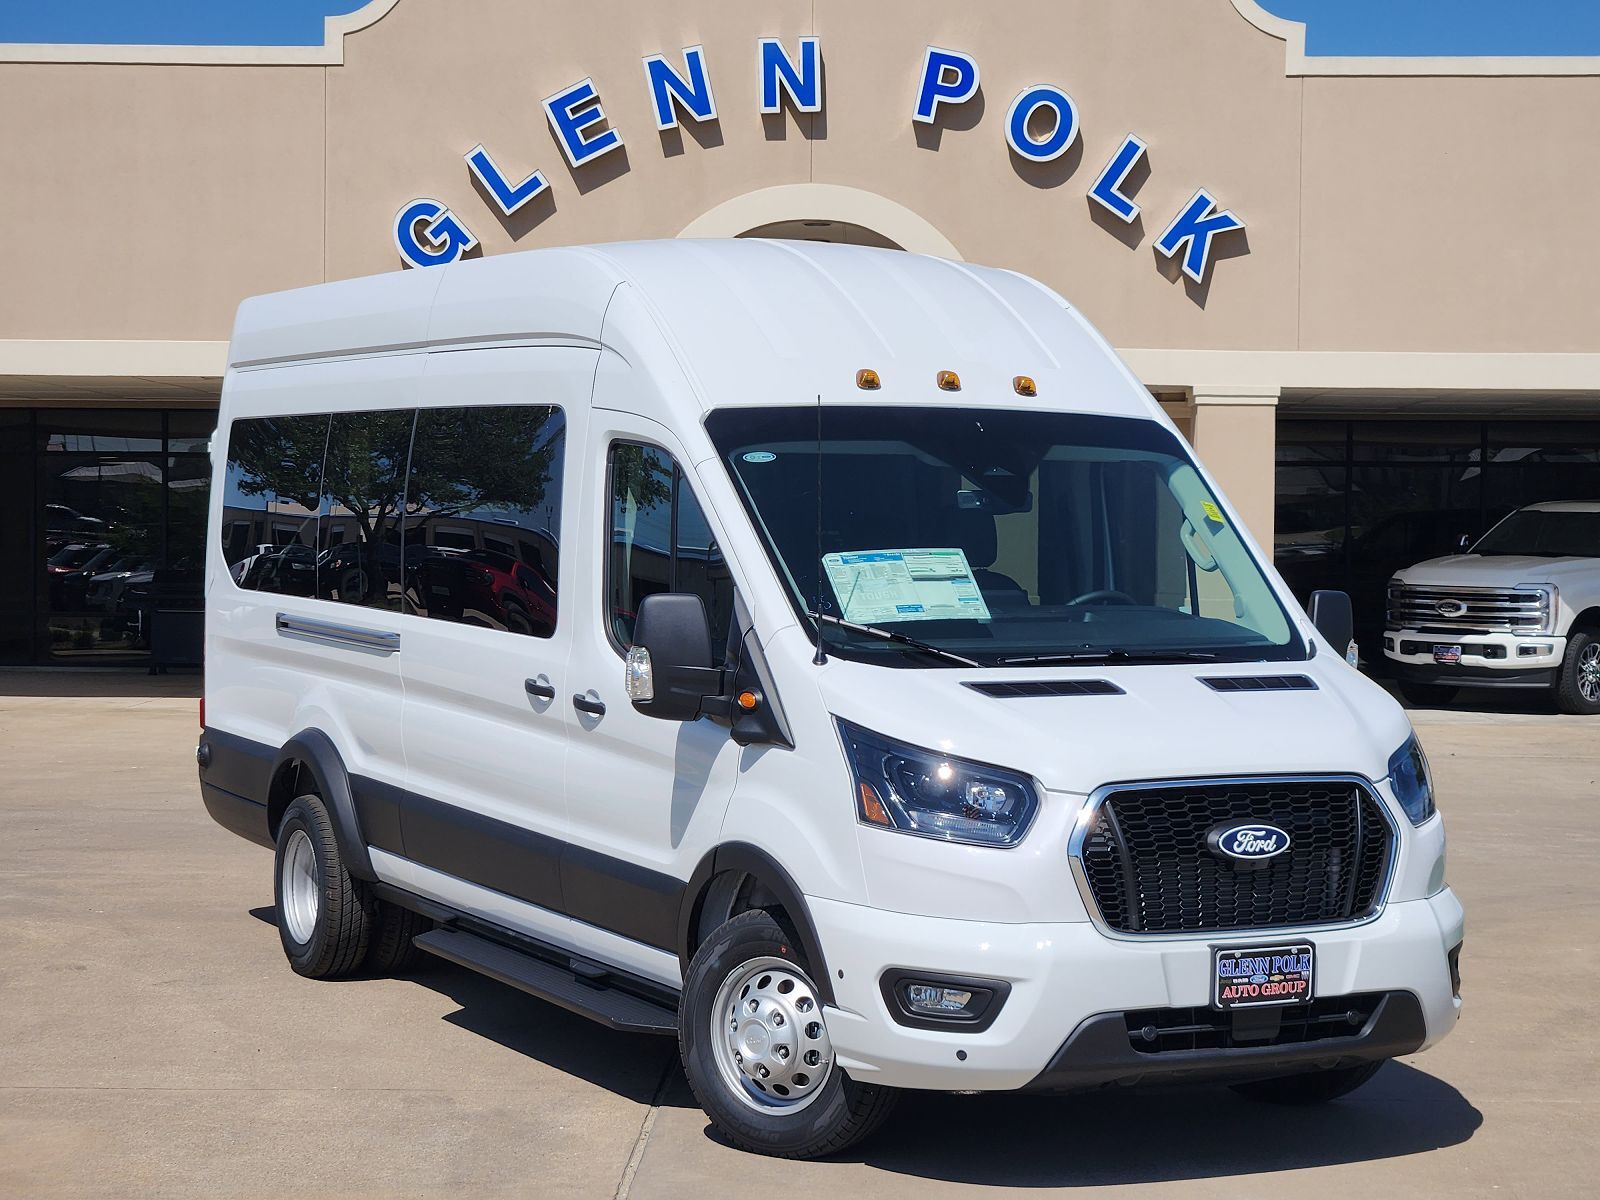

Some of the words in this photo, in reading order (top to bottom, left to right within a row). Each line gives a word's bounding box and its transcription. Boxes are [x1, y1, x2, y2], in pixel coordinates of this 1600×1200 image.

[393, 35, 821, 268] GLENN
[911, 45, 1247, 285] POLK
[1233, 830, 1277, 853] Ford
[1219, 957, 1271, 977] GLENN
[1271, 953, 1311, 974] POLK
[1221, 984, 1259, 998] AUTO
[1261, 980, 1307, 996] GROUP
